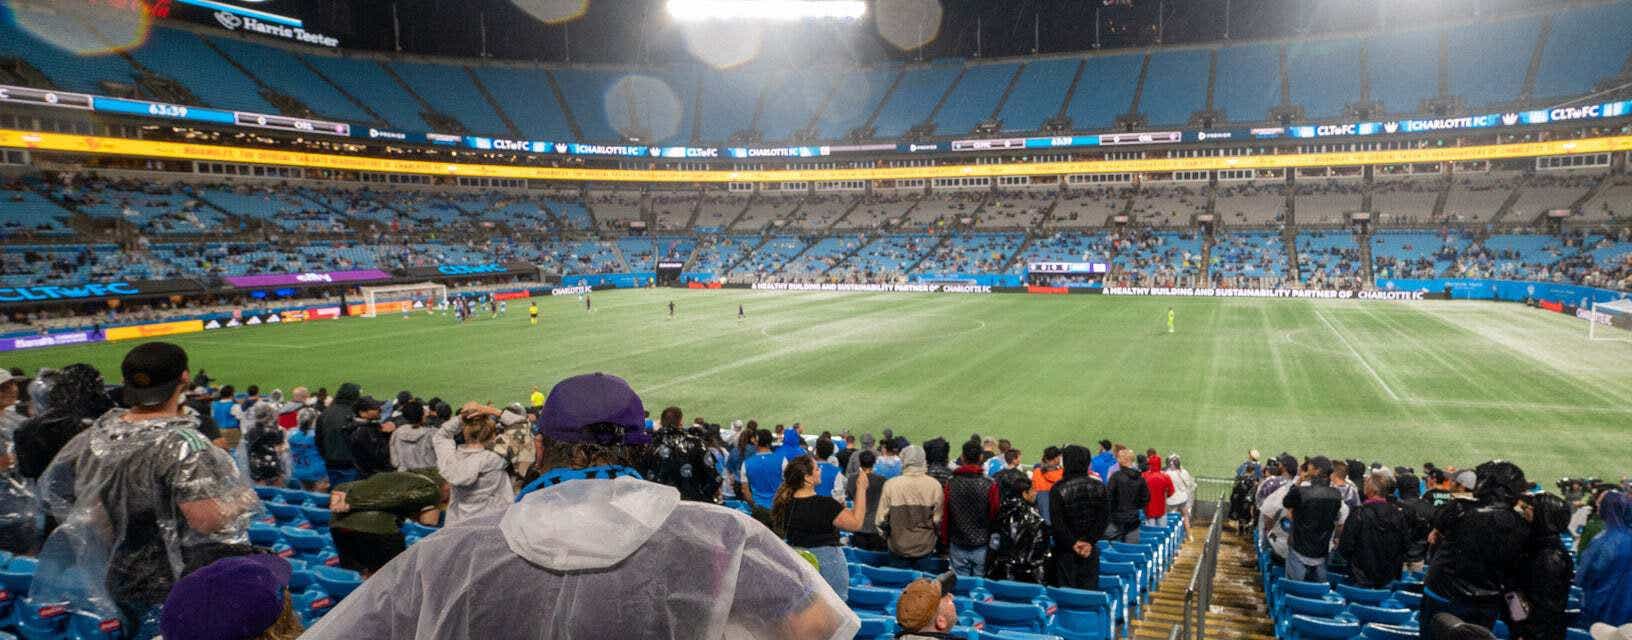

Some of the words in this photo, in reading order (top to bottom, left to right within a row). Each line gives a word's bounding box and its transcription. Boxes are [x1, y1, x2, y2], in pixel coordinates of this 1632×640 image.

[243, 17, 292, 38] Harris
[293, 28, 339, 47] Teeter
[149, 104, 187, 116] 63:39
[1412, 117, 1472, 130] CHARLOTTE
[1473, 116, 1487, 126] FC
[580, 145, 627, 155] CHARLOTTE
[943, 285, 982, 293] CHARLOTTE
[982, 285, 992, 293] FC
[1110, 288, 1150, 296] HEALTHY
[1150, 288, 1194, 296] BUILDING
[1215, 289, 1291, 297] SUSTAINABILITY
[1292, 290, 1338, 298] PARTNER
[1338, 290, 1353, 298] OF
[1358, 291, 1411, 300] CHARLOTTE
[1412, 292, 1424, 300] FC
